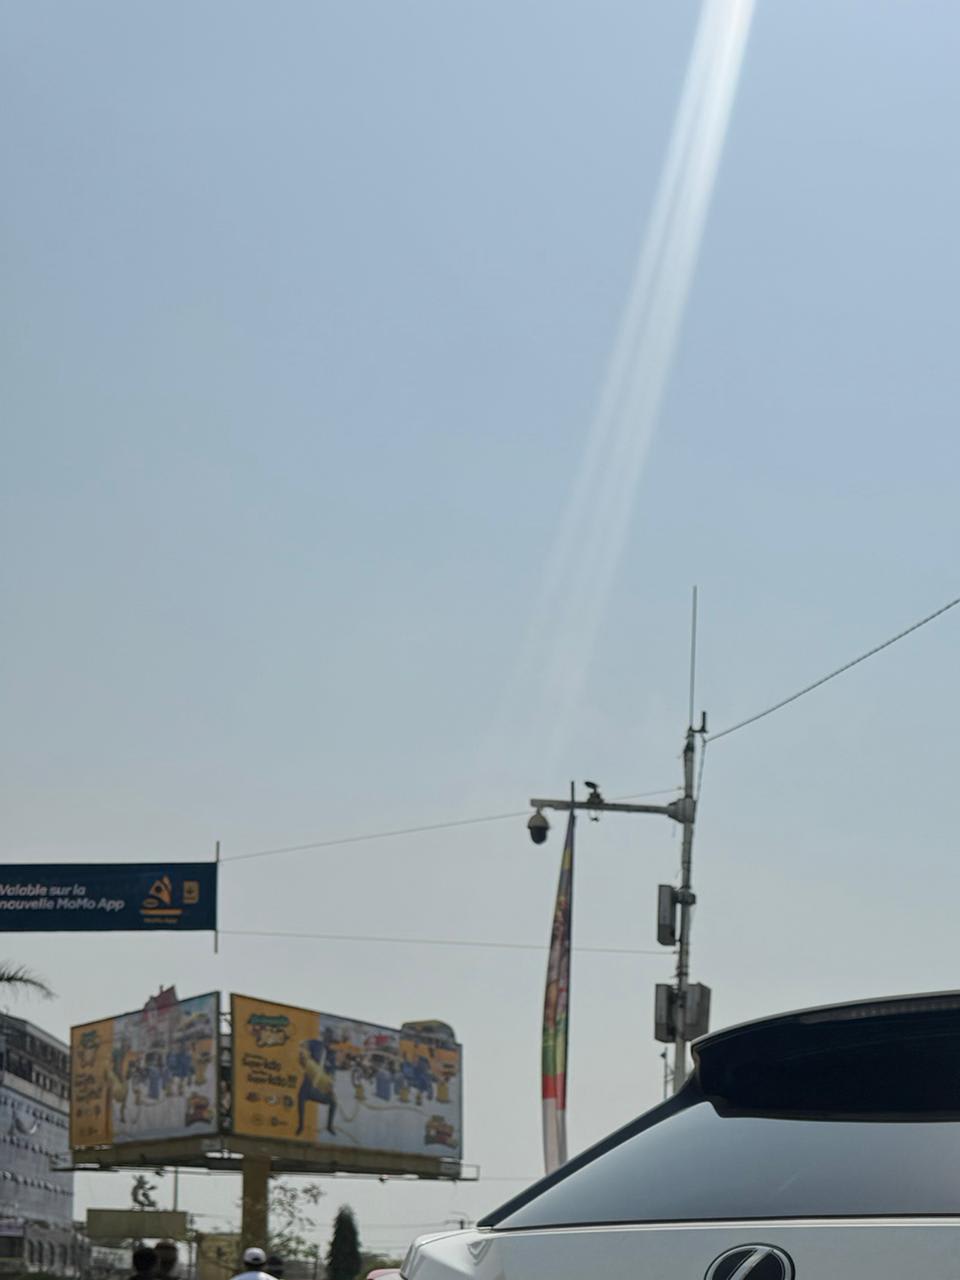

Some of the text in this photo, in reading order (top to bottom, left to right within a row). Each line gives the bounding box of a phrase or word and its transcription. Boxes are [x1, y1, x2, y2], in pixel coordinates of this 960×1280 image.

[0, 883, 86, 896] Valable sur la
[0, 898, 125, 912] nouvelle MoMo App
